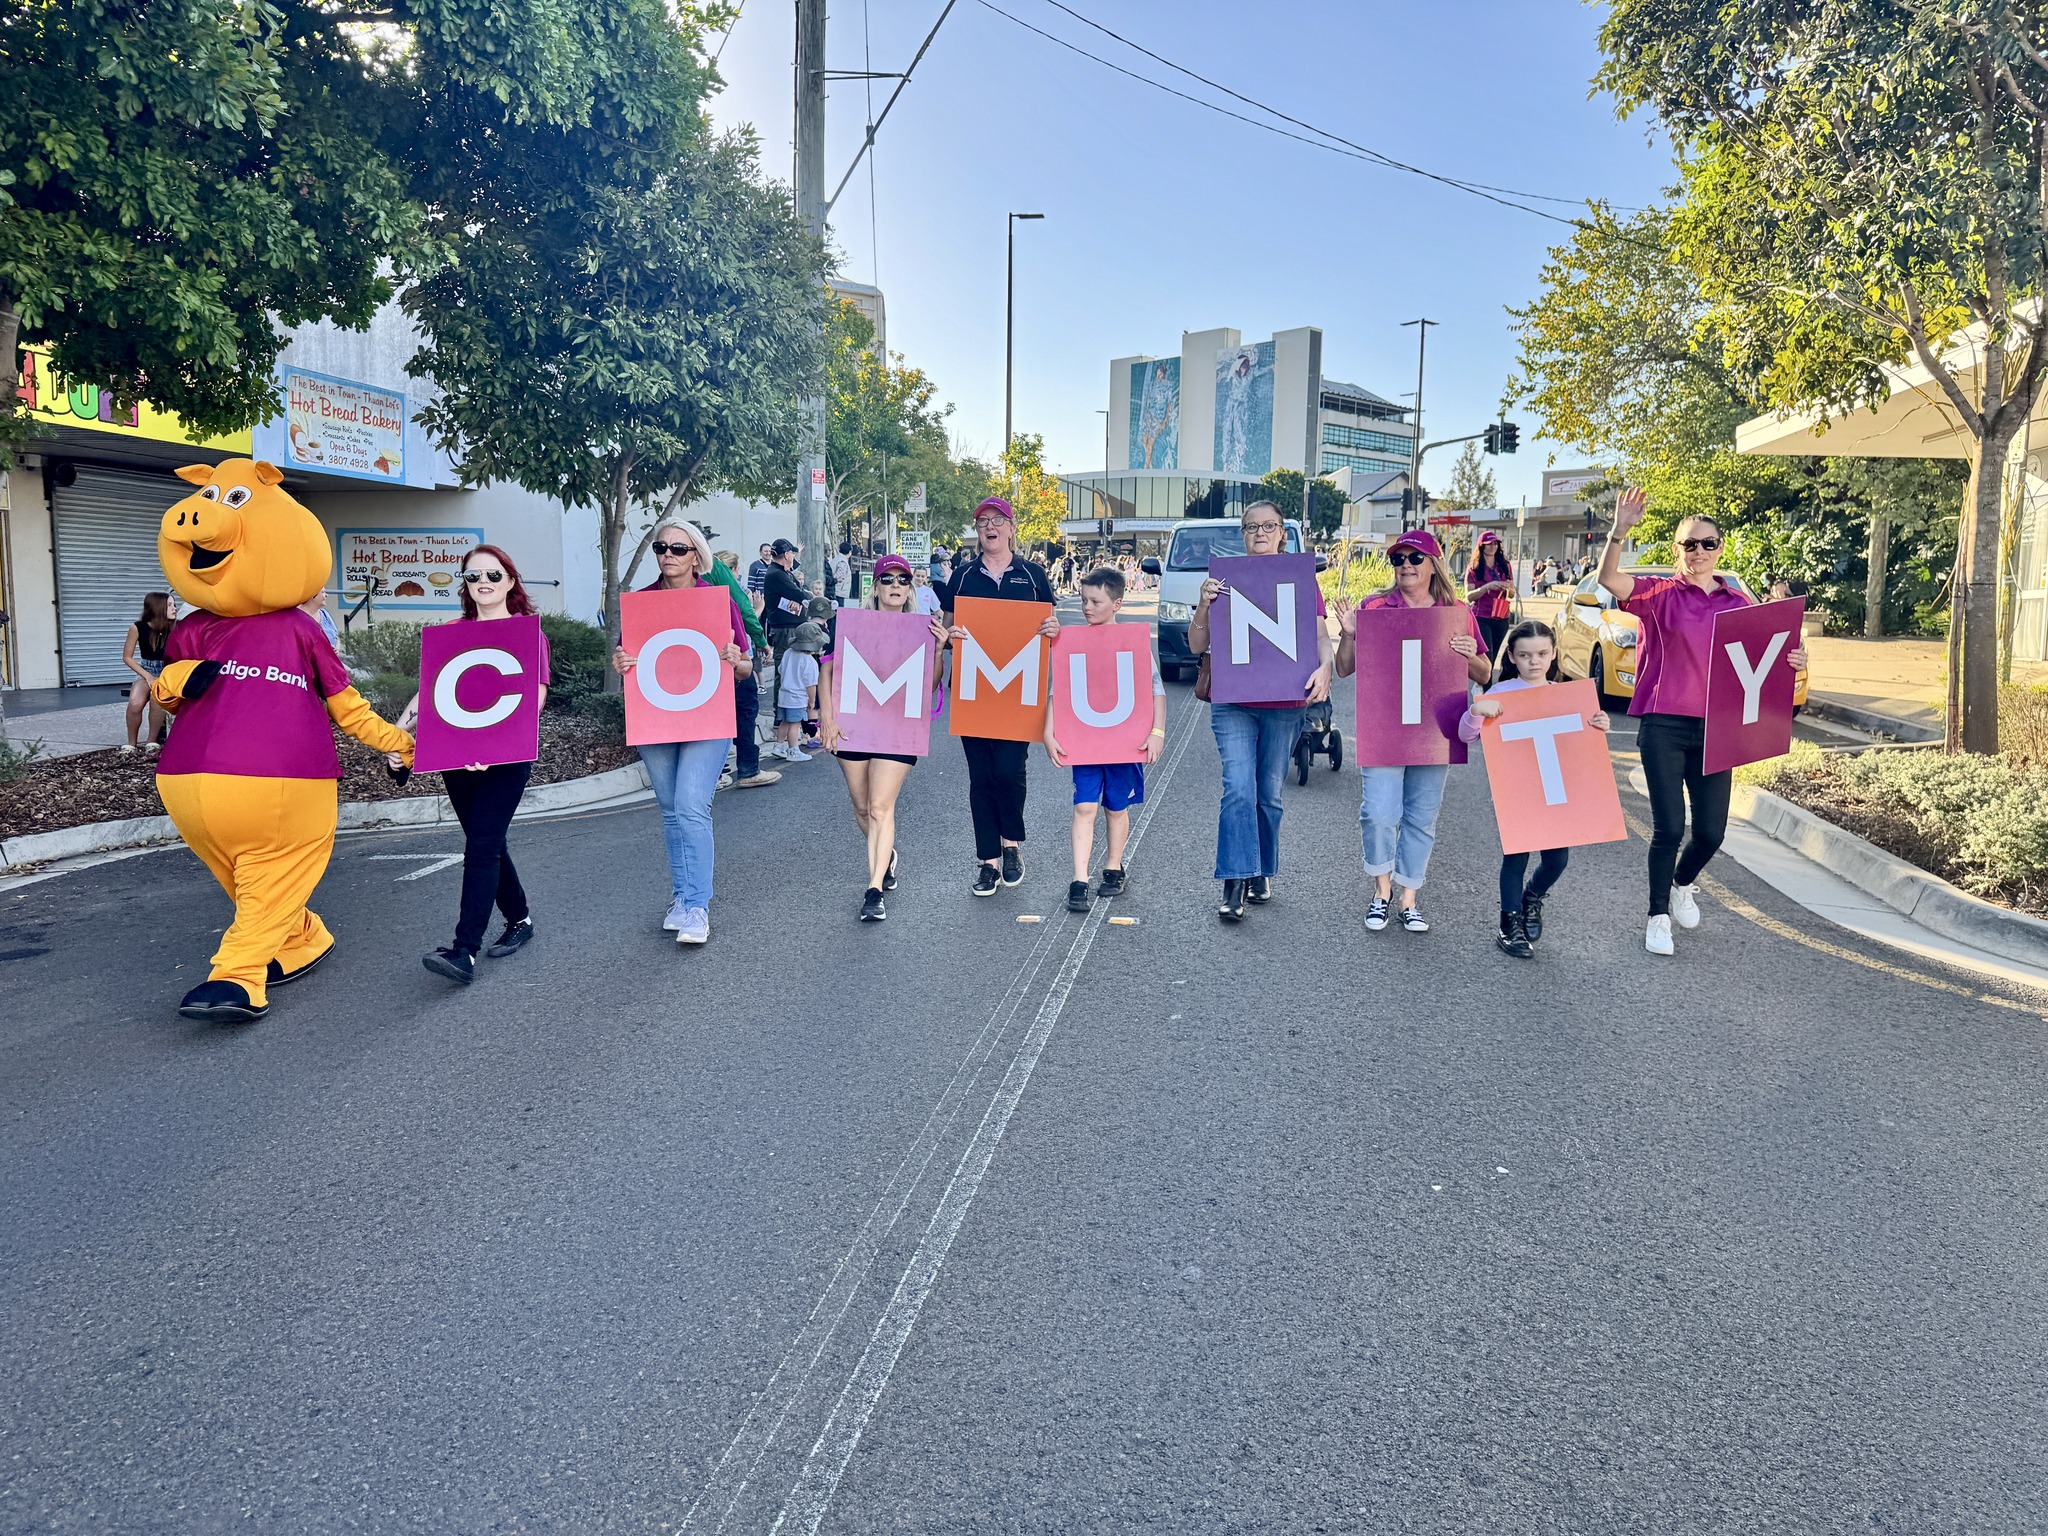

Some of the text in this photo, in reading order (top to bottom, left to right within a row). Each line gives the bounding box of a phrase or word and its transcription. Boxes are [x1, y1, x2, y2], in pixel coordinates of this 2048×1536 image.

[290, 391, 402, 437] Hot Bread Bakery
[292, 375, 307, 389] The
[308, 379, 326, 392] Best
[328, 386, 336, 396] in
[337, 386, 357, 400] Town
[363, 391, 385, 407] Thuan
[385, 397, 400, 410] Loi's
[328, 454, 369, 469] 3807 4928
[329, 440, 368, 459] Open 6 Days
[346, 566, 368, 574] SALAD
[352, 536, 368, 545] The
[369, 536, 386, 545] Best
[388, 537, 396, 545] in
[397, 536, 418, 545] Town
[426, 536, 451, 545] Thuan
[452, 536, 469, 545] Loi's
[353, 549, 380, 564] Hot
[380, 549, 420, 564] Bread
[1229, 583, 1297, 665] N
[219, 660, 308, 691] digo Bank
[434, 649, 523, 729] C
[636, 628, 721, 712] O
[839, 636, 926, 719] M
[959, 625, 1041, 706] M
[1069, 651, 1135, 728] U
[1402, 640, 1421, 724] I
[1725, 631, 1790, 725] Y
[1499, 712, 1585, 806] T
